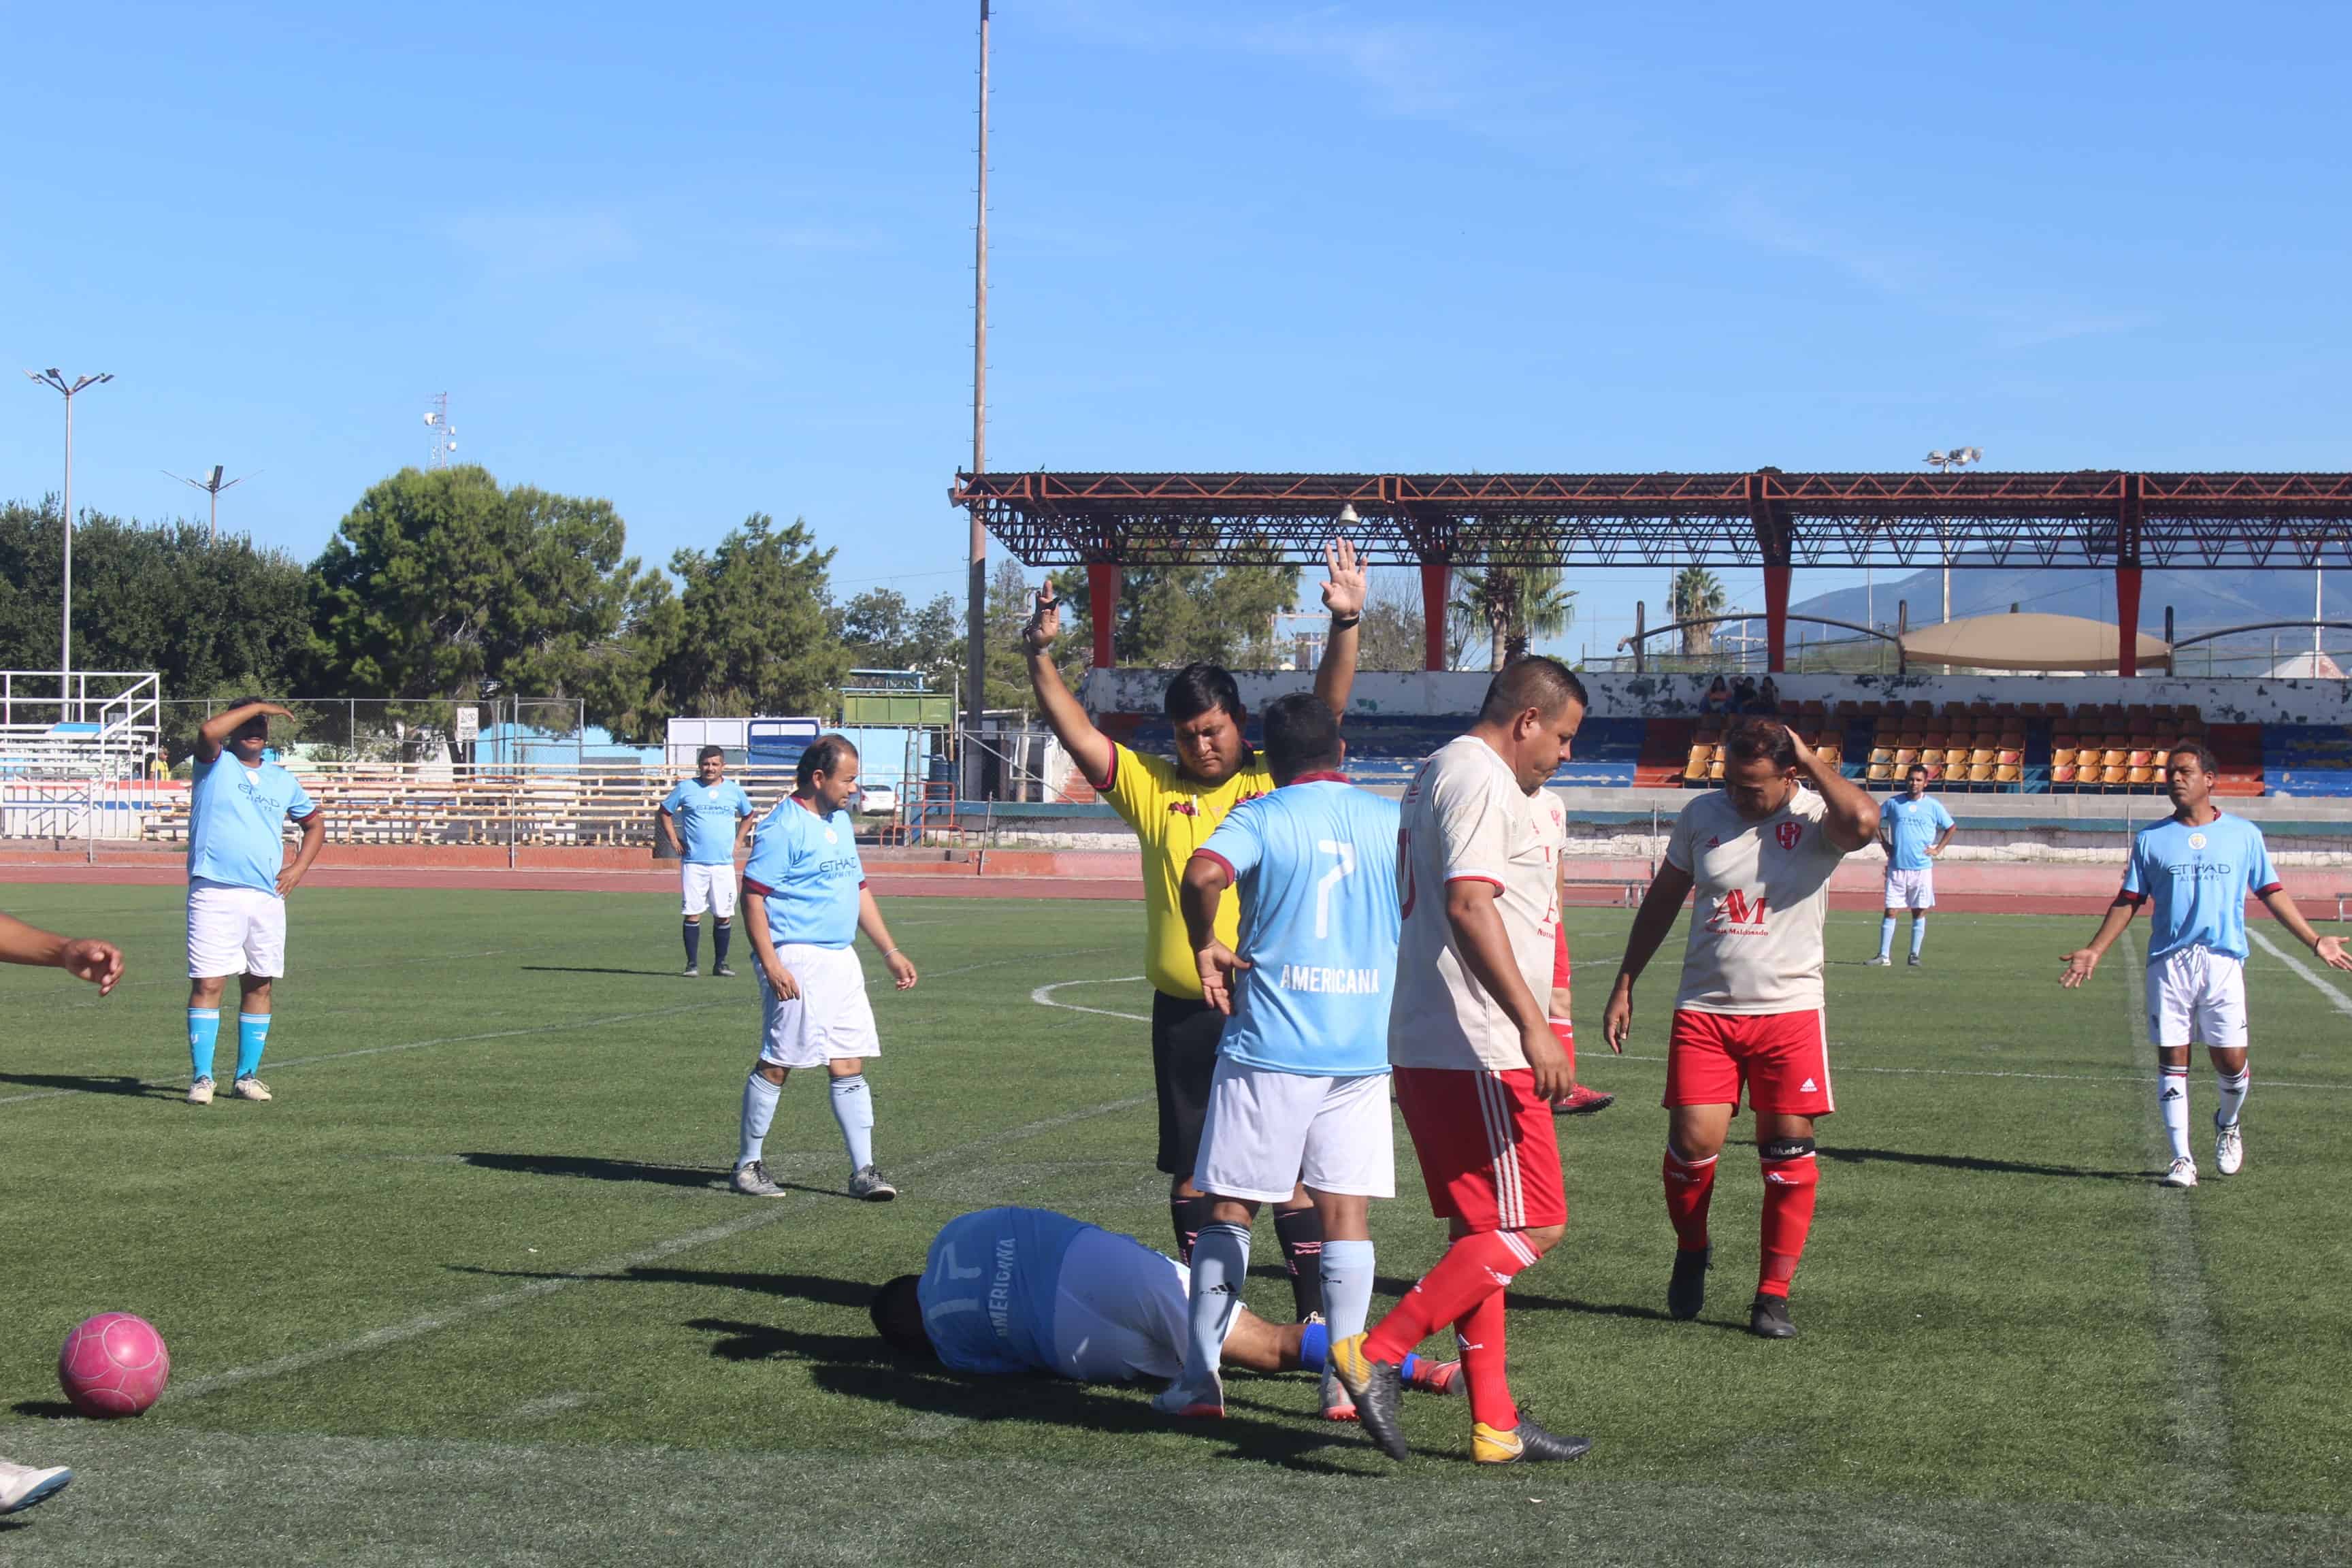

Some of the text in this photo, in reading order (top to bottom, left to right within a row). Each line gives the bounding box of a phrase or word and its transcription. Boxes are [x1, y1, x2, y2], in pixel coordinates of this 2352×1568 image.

[2166, 863, 2232, 876] ETIHAD
[1315, 839, 1356, 940] 7
[1279, 964, 1380, 994] AMERICANA
